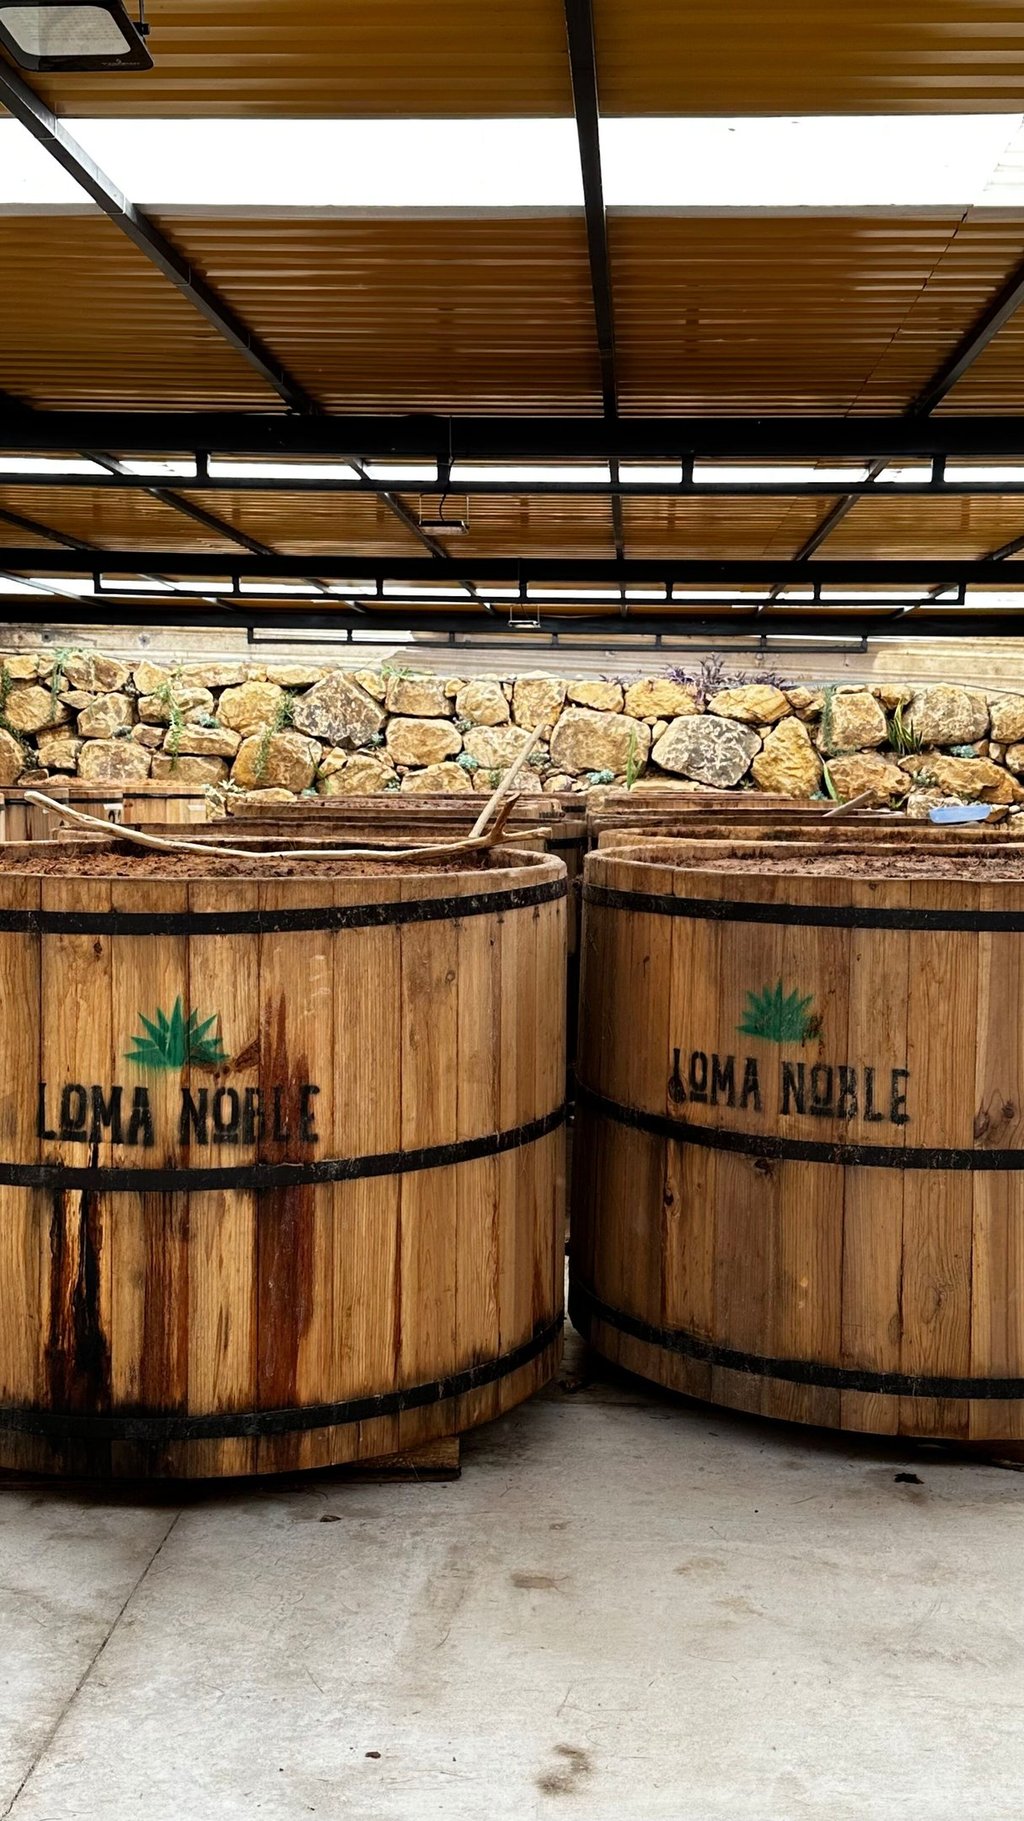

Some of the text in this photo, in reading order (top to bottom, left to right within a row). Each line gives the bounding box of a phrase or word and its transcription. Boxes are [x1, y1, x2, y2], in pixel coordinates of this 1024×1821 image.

[36, 1082, 320, 1147] LOMA NOBLE
[668, 1047, 910, 1125] LOMA NOBLE
